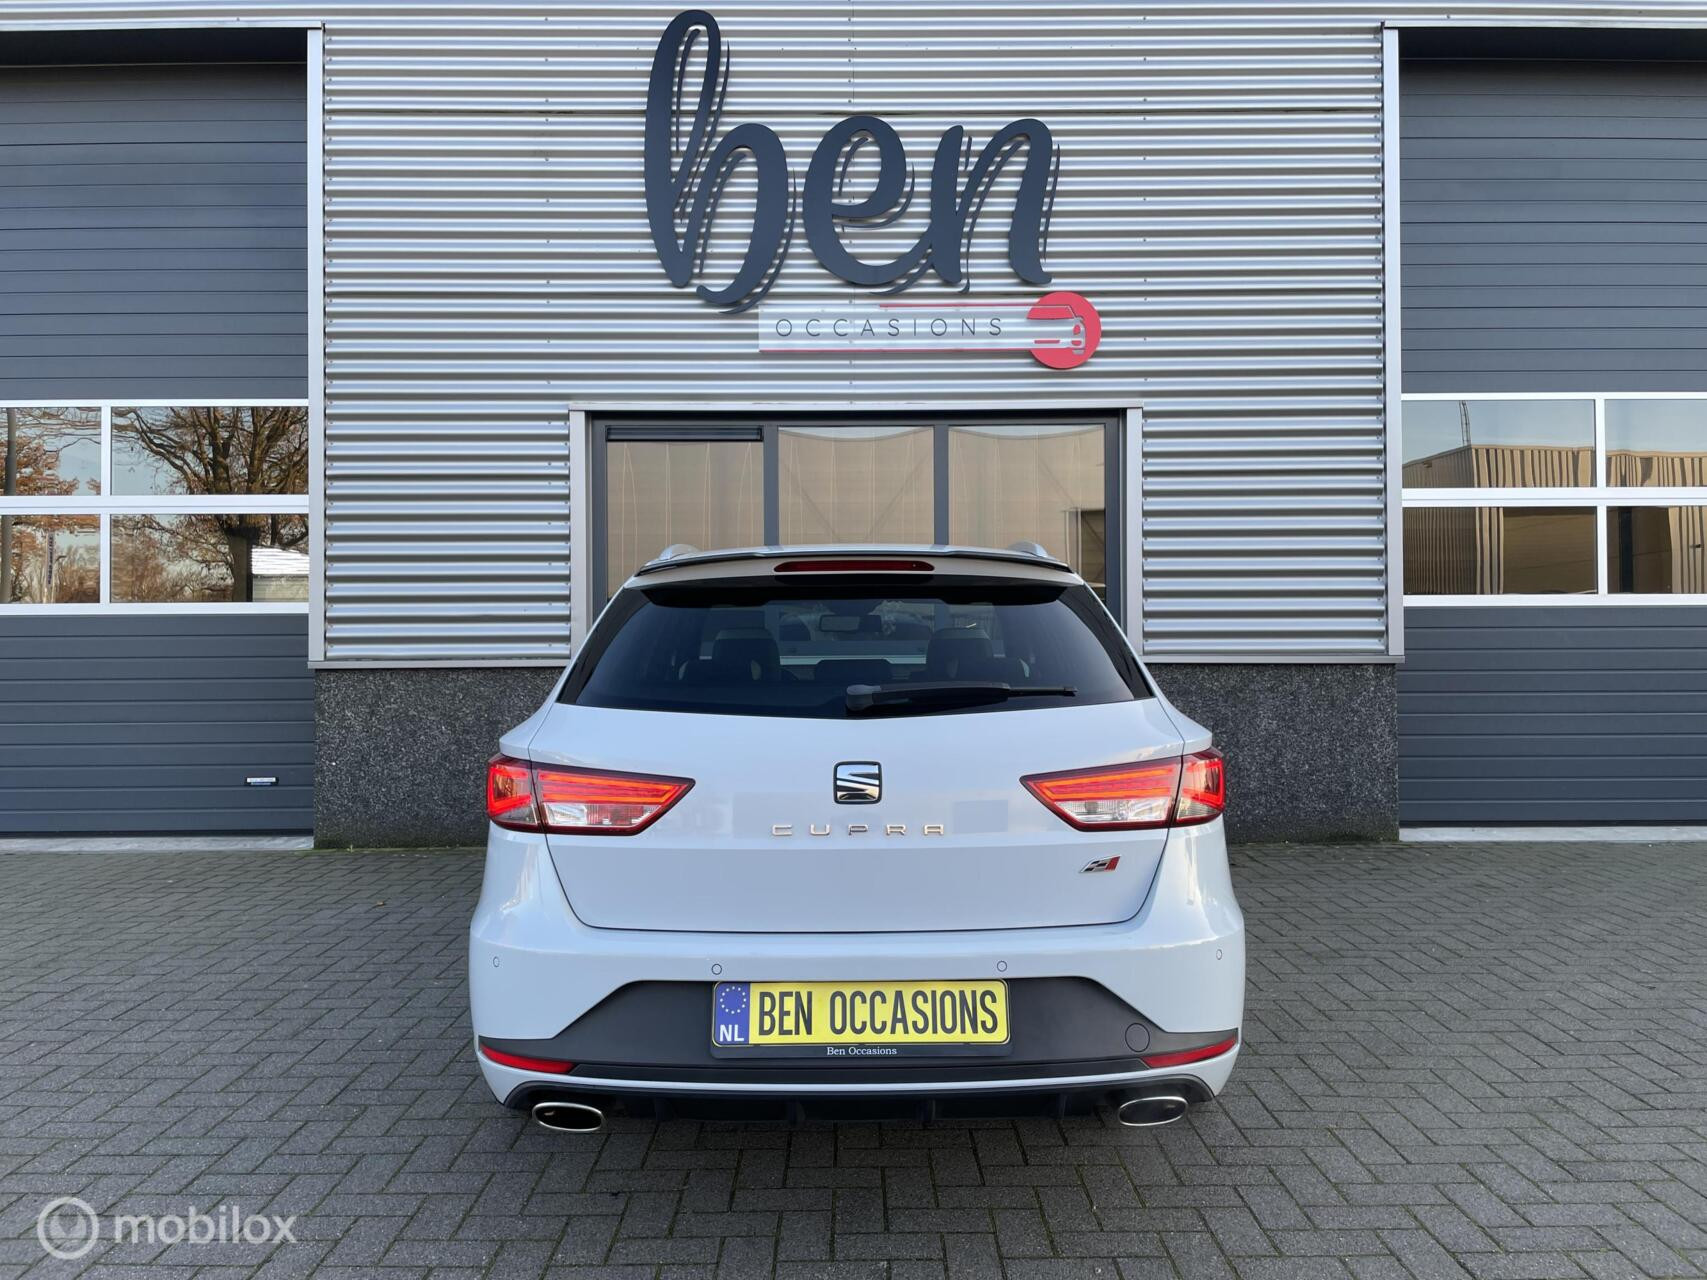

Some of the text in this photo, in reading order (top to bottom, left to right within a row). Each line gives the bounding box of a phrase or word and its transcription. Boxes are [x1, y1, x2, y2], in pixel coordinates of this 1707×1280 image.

[645, 9, 1053, 305] ben
[775, 317, 1002, 337] OCCASIONS
[771, 823, 945, 836] CUPRA
[758, 989, 998, 1036] BEN OCCASIONS
[719, 1024, 744, 1042] NL
[826, 1046, 897, 1055] Ben Occasions
